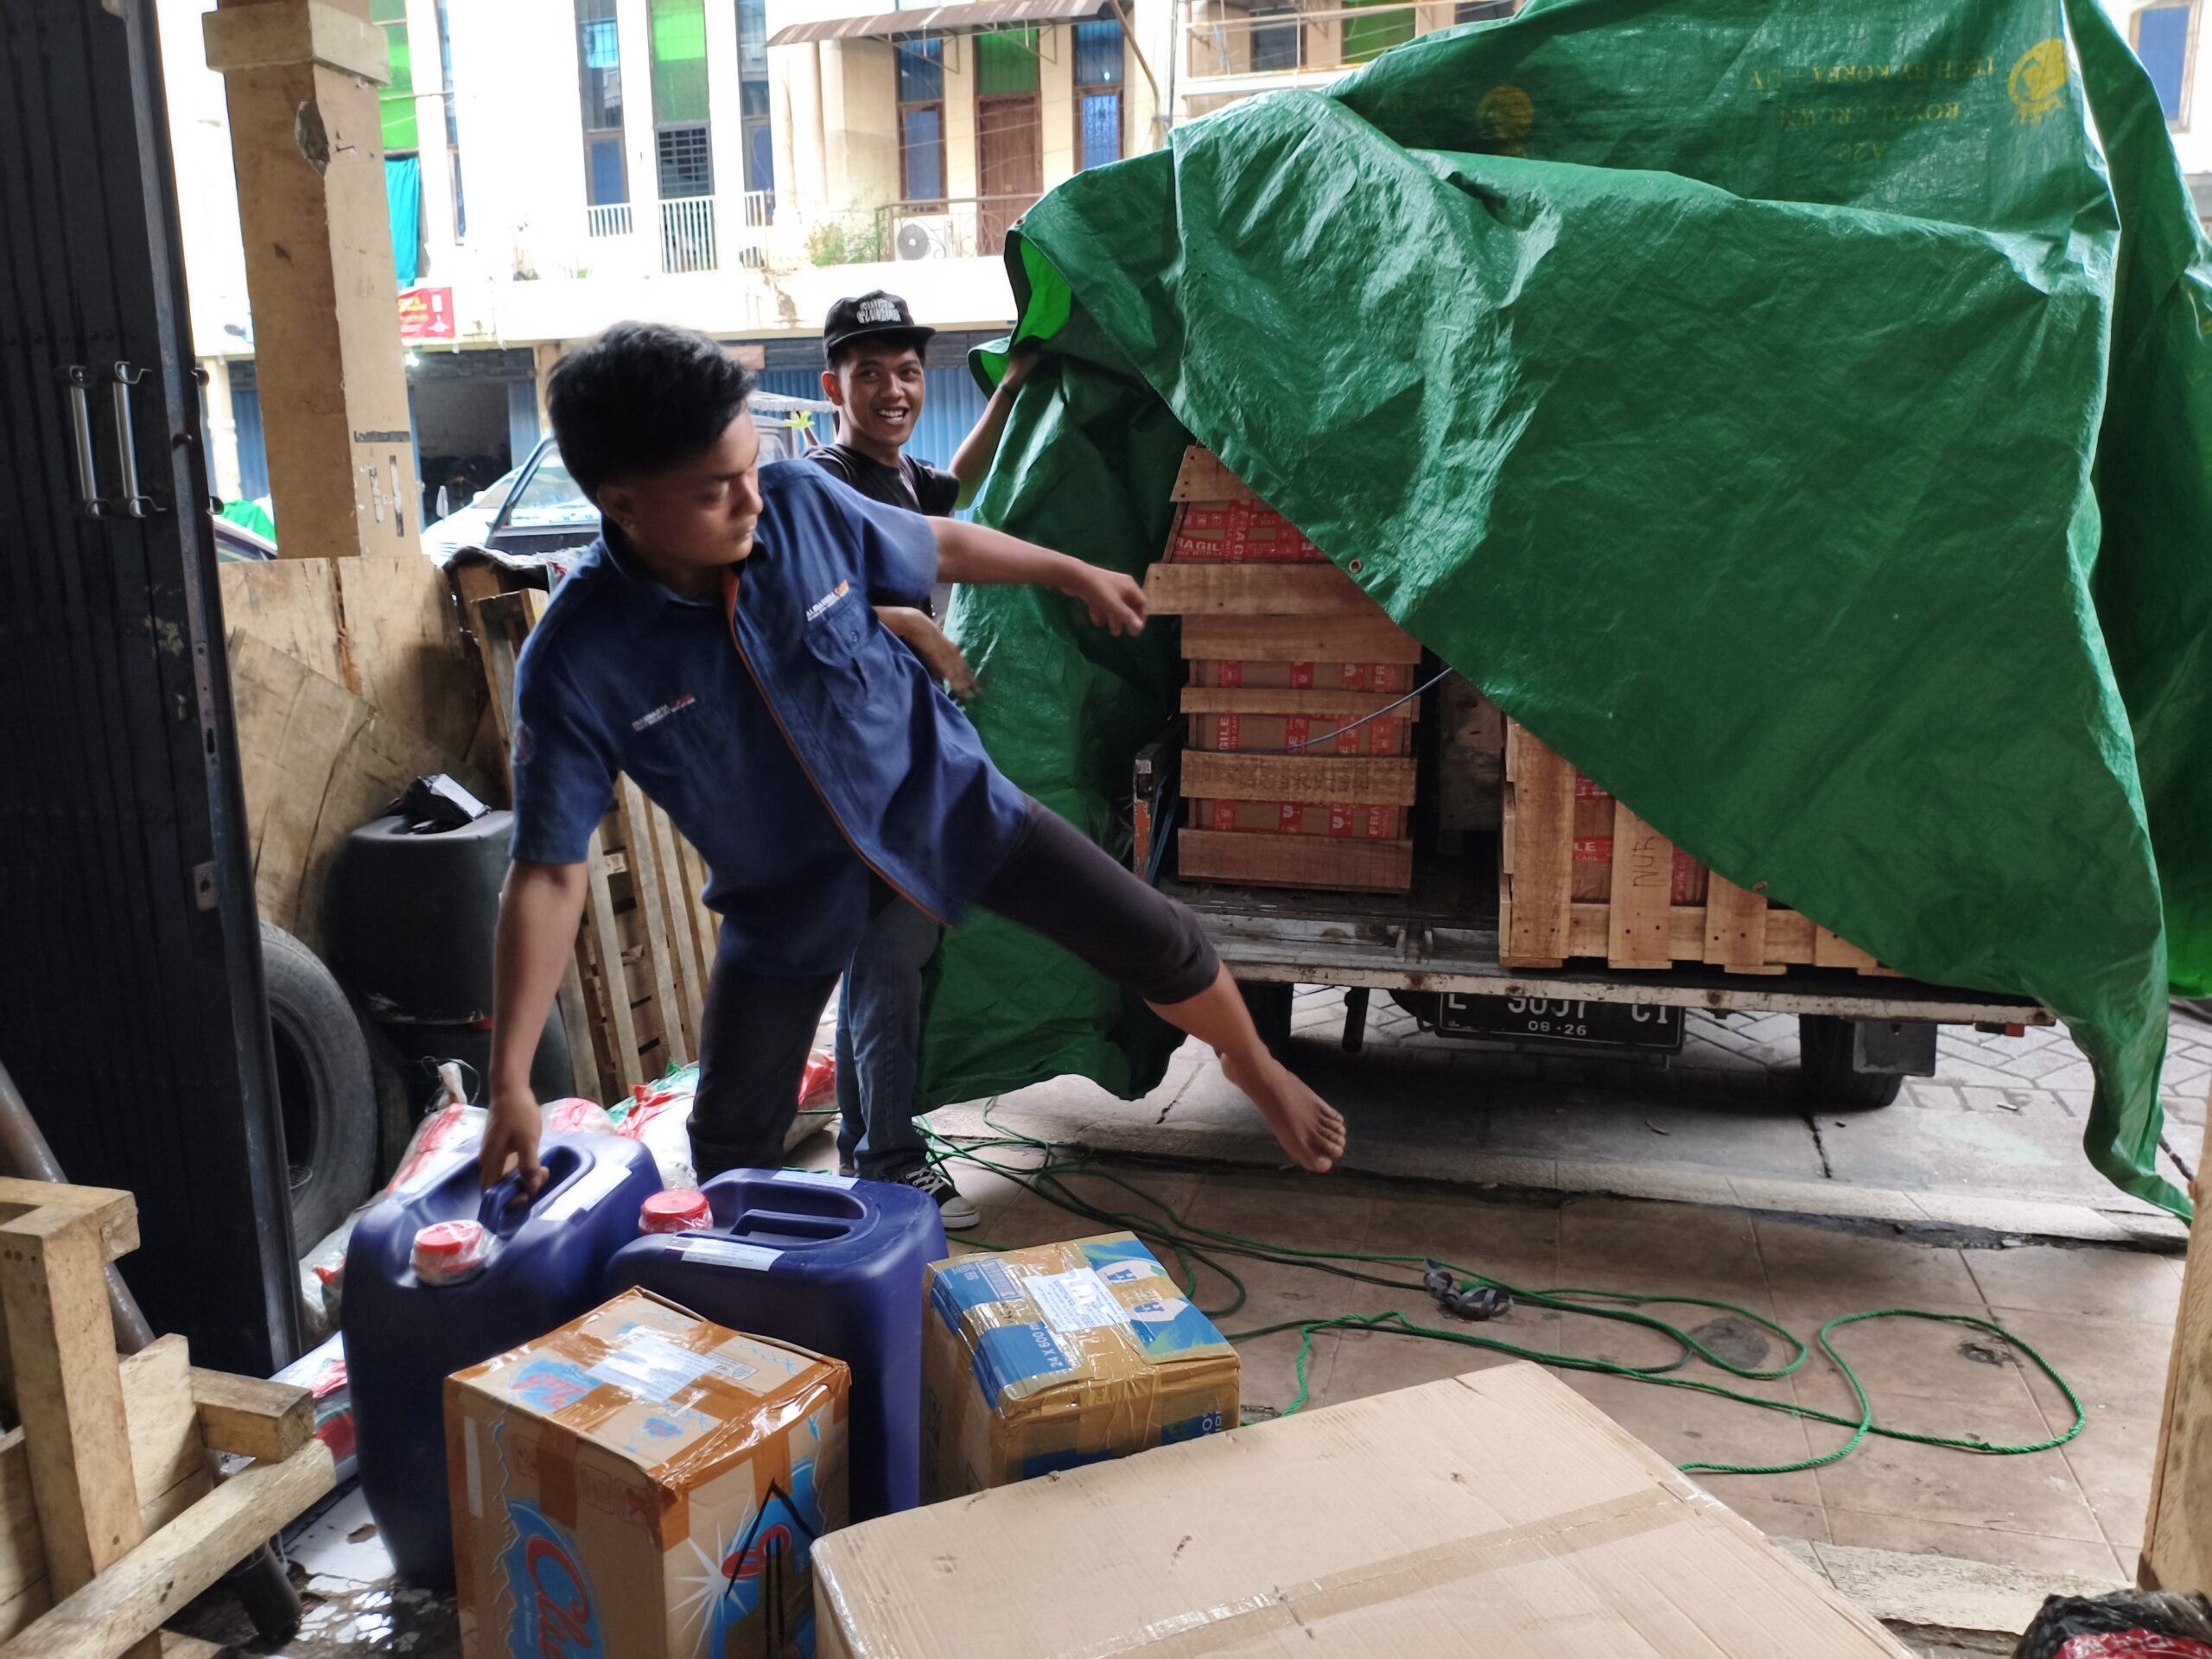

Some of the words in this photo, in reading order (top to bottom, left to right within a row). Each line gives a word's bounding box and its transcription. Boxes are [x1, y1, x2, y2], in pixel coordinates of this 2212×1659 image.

[1812, 65, 1889, 85] KOREA
[1033, 1332, 1051, 1348] 600
[1048, 1356, 1064, 1369] 24
